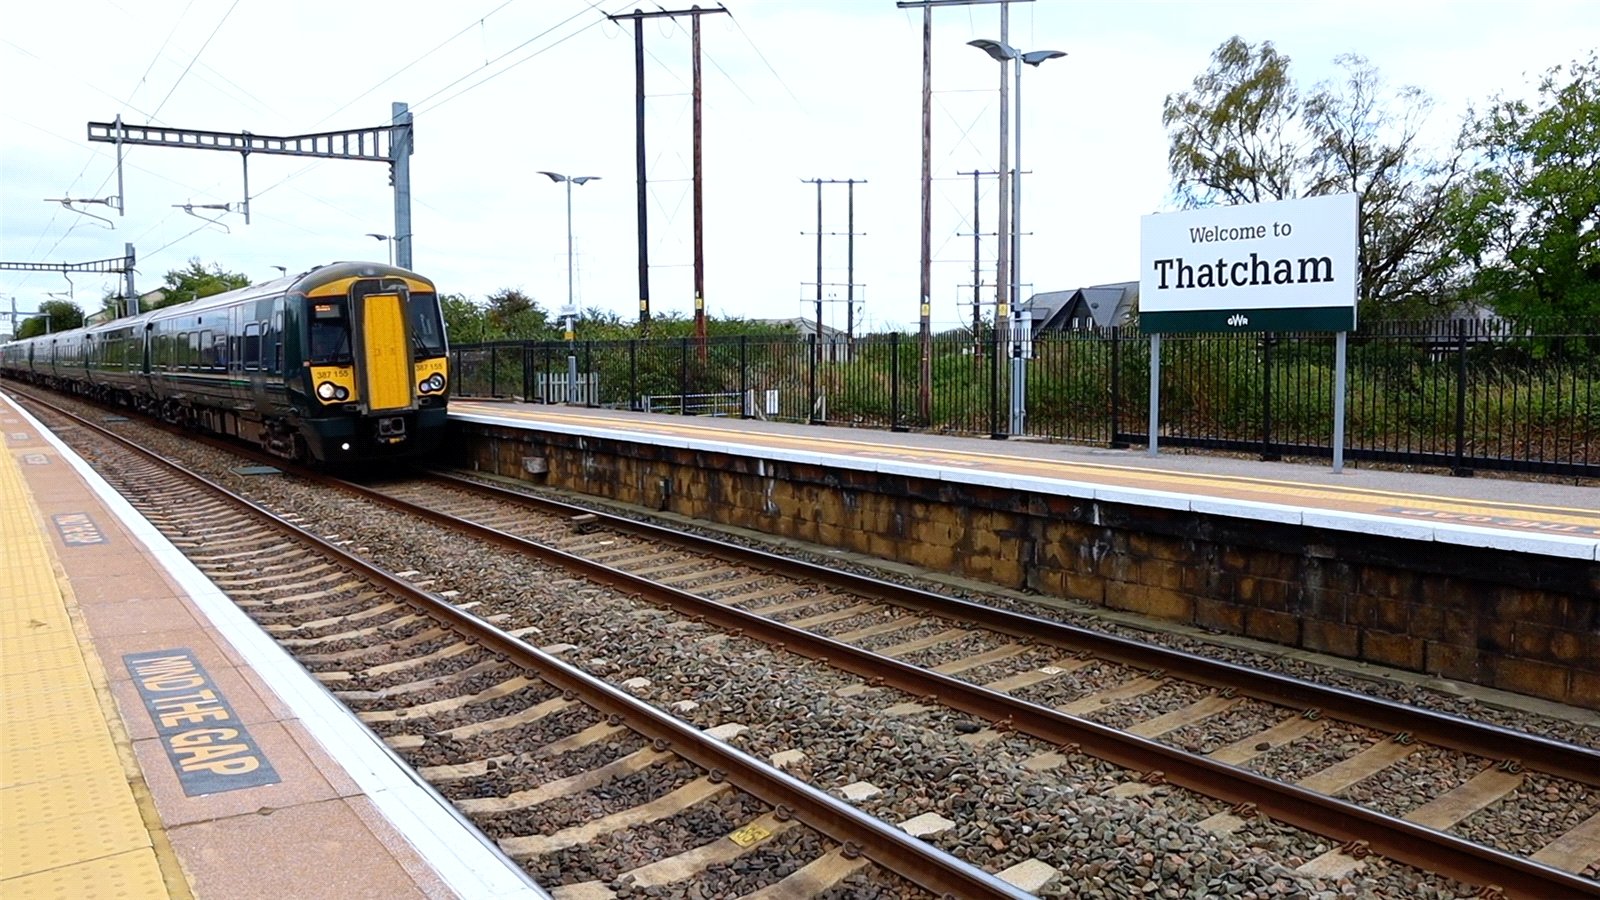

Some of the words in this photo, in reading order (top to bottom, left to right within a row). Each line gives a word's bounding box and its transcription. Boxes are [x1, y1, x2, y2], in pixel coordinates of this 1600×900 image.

[1189, 223, 1266, 244] Welcome
[1273, 221, 1292, 237] to
[1153, 252, 1334, 290] Thatcham
[1227, 313, 1249, 327] GWR
[316, 371, 331, 380] 387
[334, 369, 349, 378] 155
[416, 363, 428, 372] 387
[430, 362, 443, 370] 155
[132, 655, 205, 692] MIND
[152, 689, 229, 728] THE
[170, 728, 260, 775] GAP
